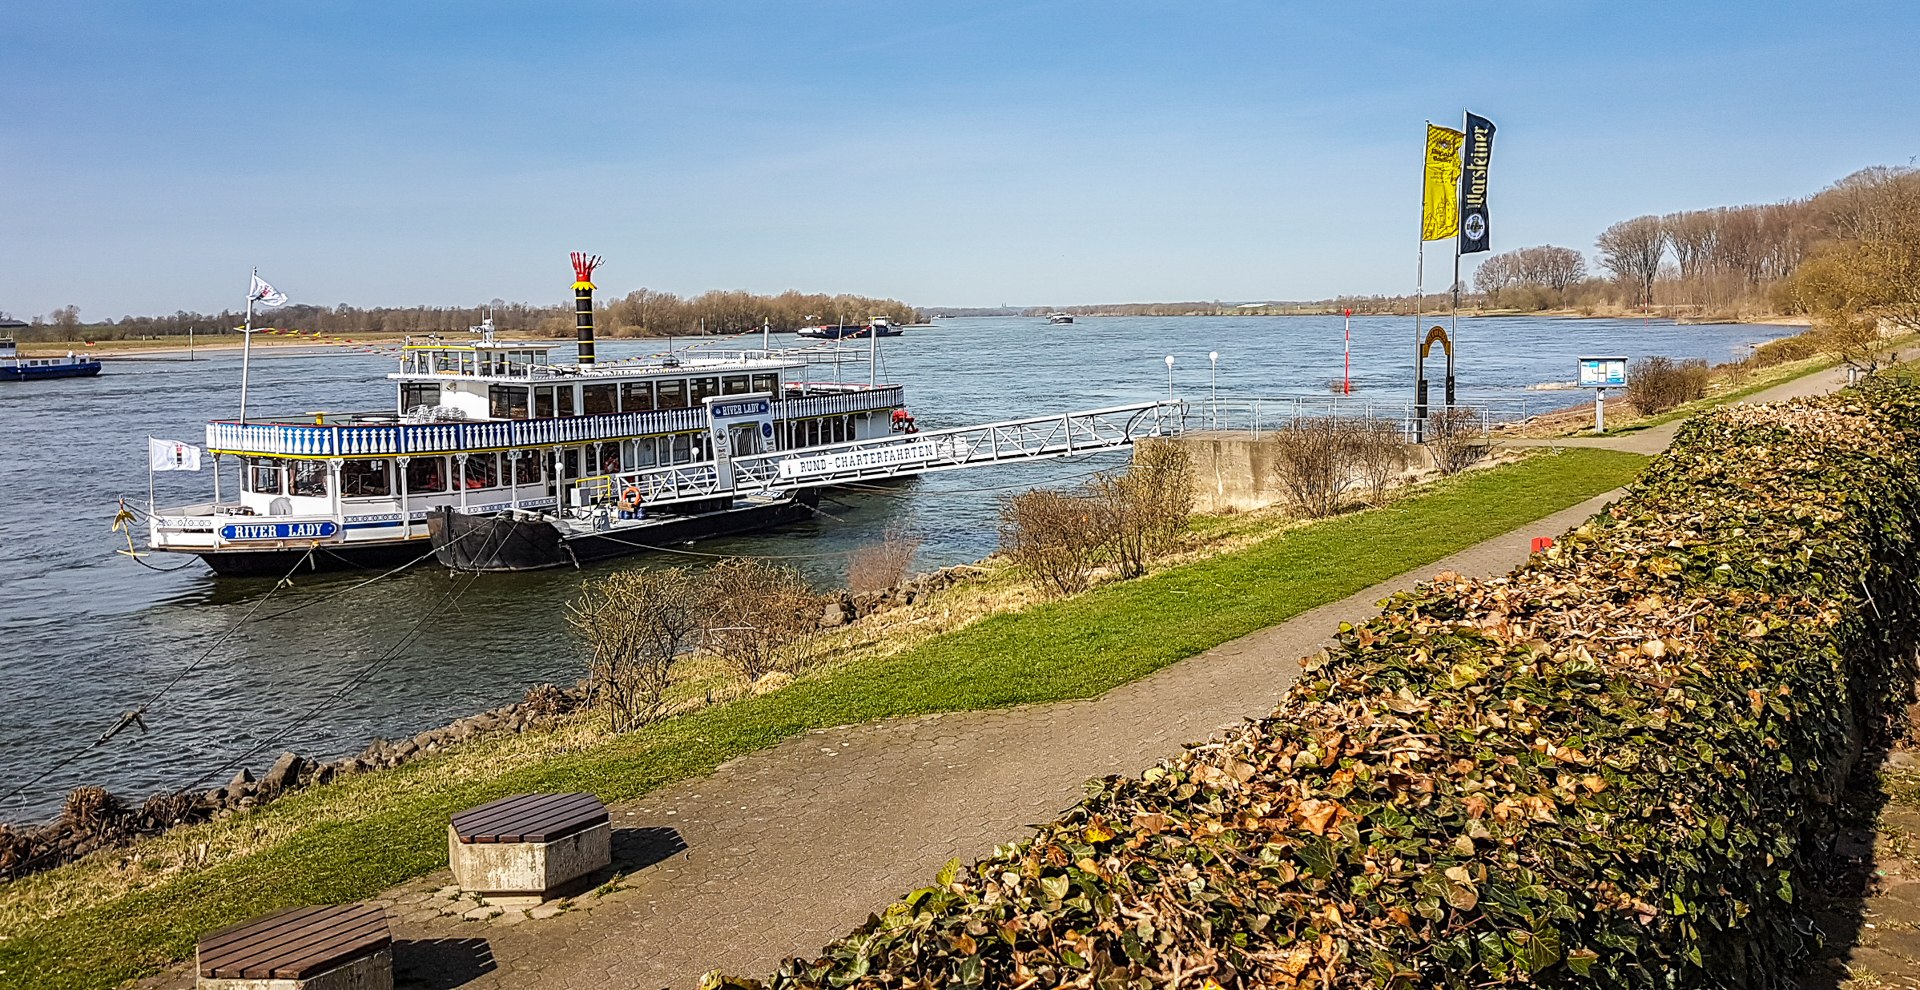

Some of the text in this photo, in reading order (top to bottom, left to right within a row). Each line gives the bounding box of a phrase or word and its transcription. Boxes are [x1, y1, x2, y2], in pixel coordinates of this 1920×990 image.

[1466, 125, 1489, 209] Warsteiner
[722, 403, 759, 416] RIVER LADY
[234, 523, 323, 538] RIVER LADY
